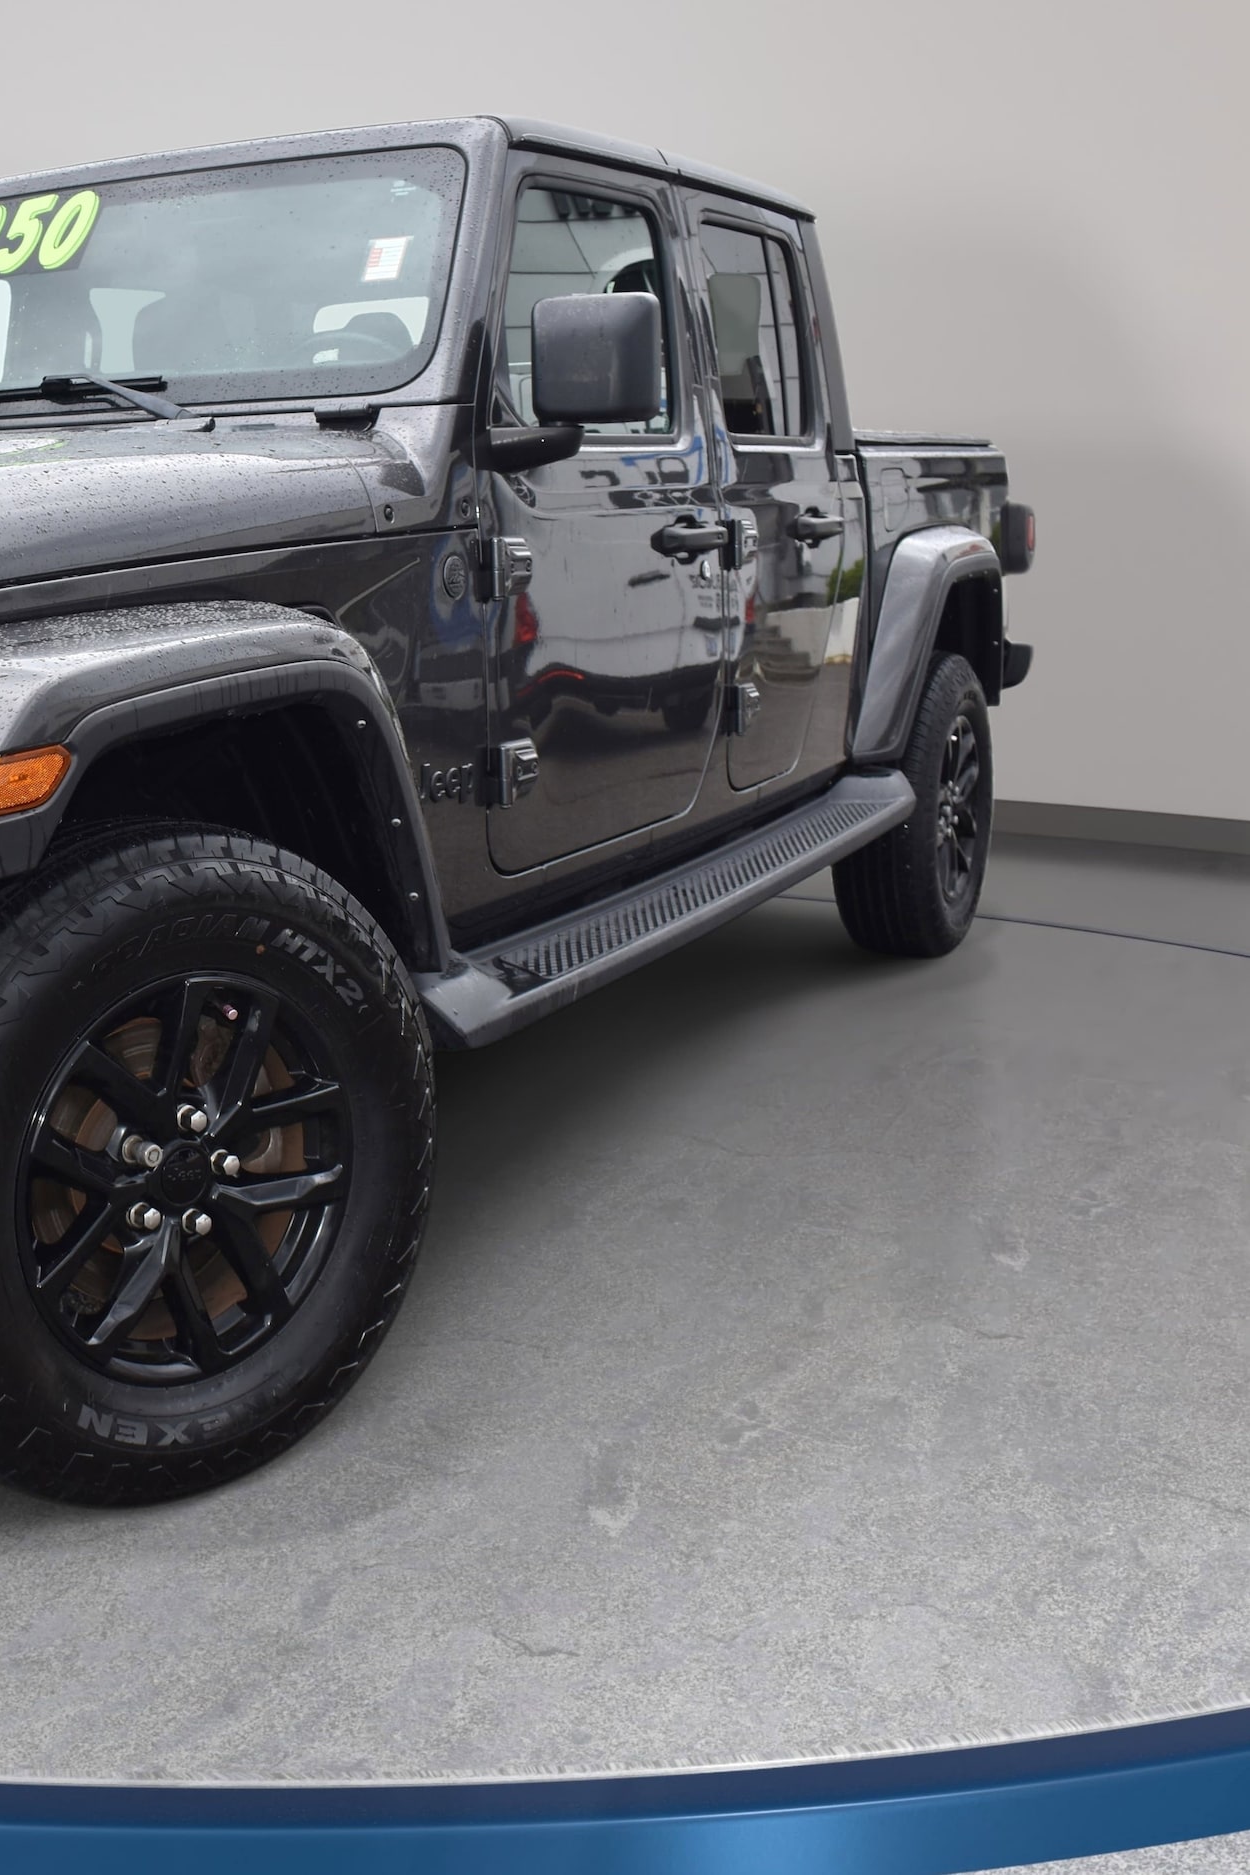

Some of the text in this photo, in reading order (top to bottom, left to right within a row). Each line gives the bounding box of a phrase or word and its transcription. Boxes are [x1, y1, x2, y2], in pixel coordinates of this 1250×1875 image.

[419, 762, 474, 804] Jeep
[270, 927, 365, 1006] HTX2
[76, 1401, 258, 1446] EXEN
